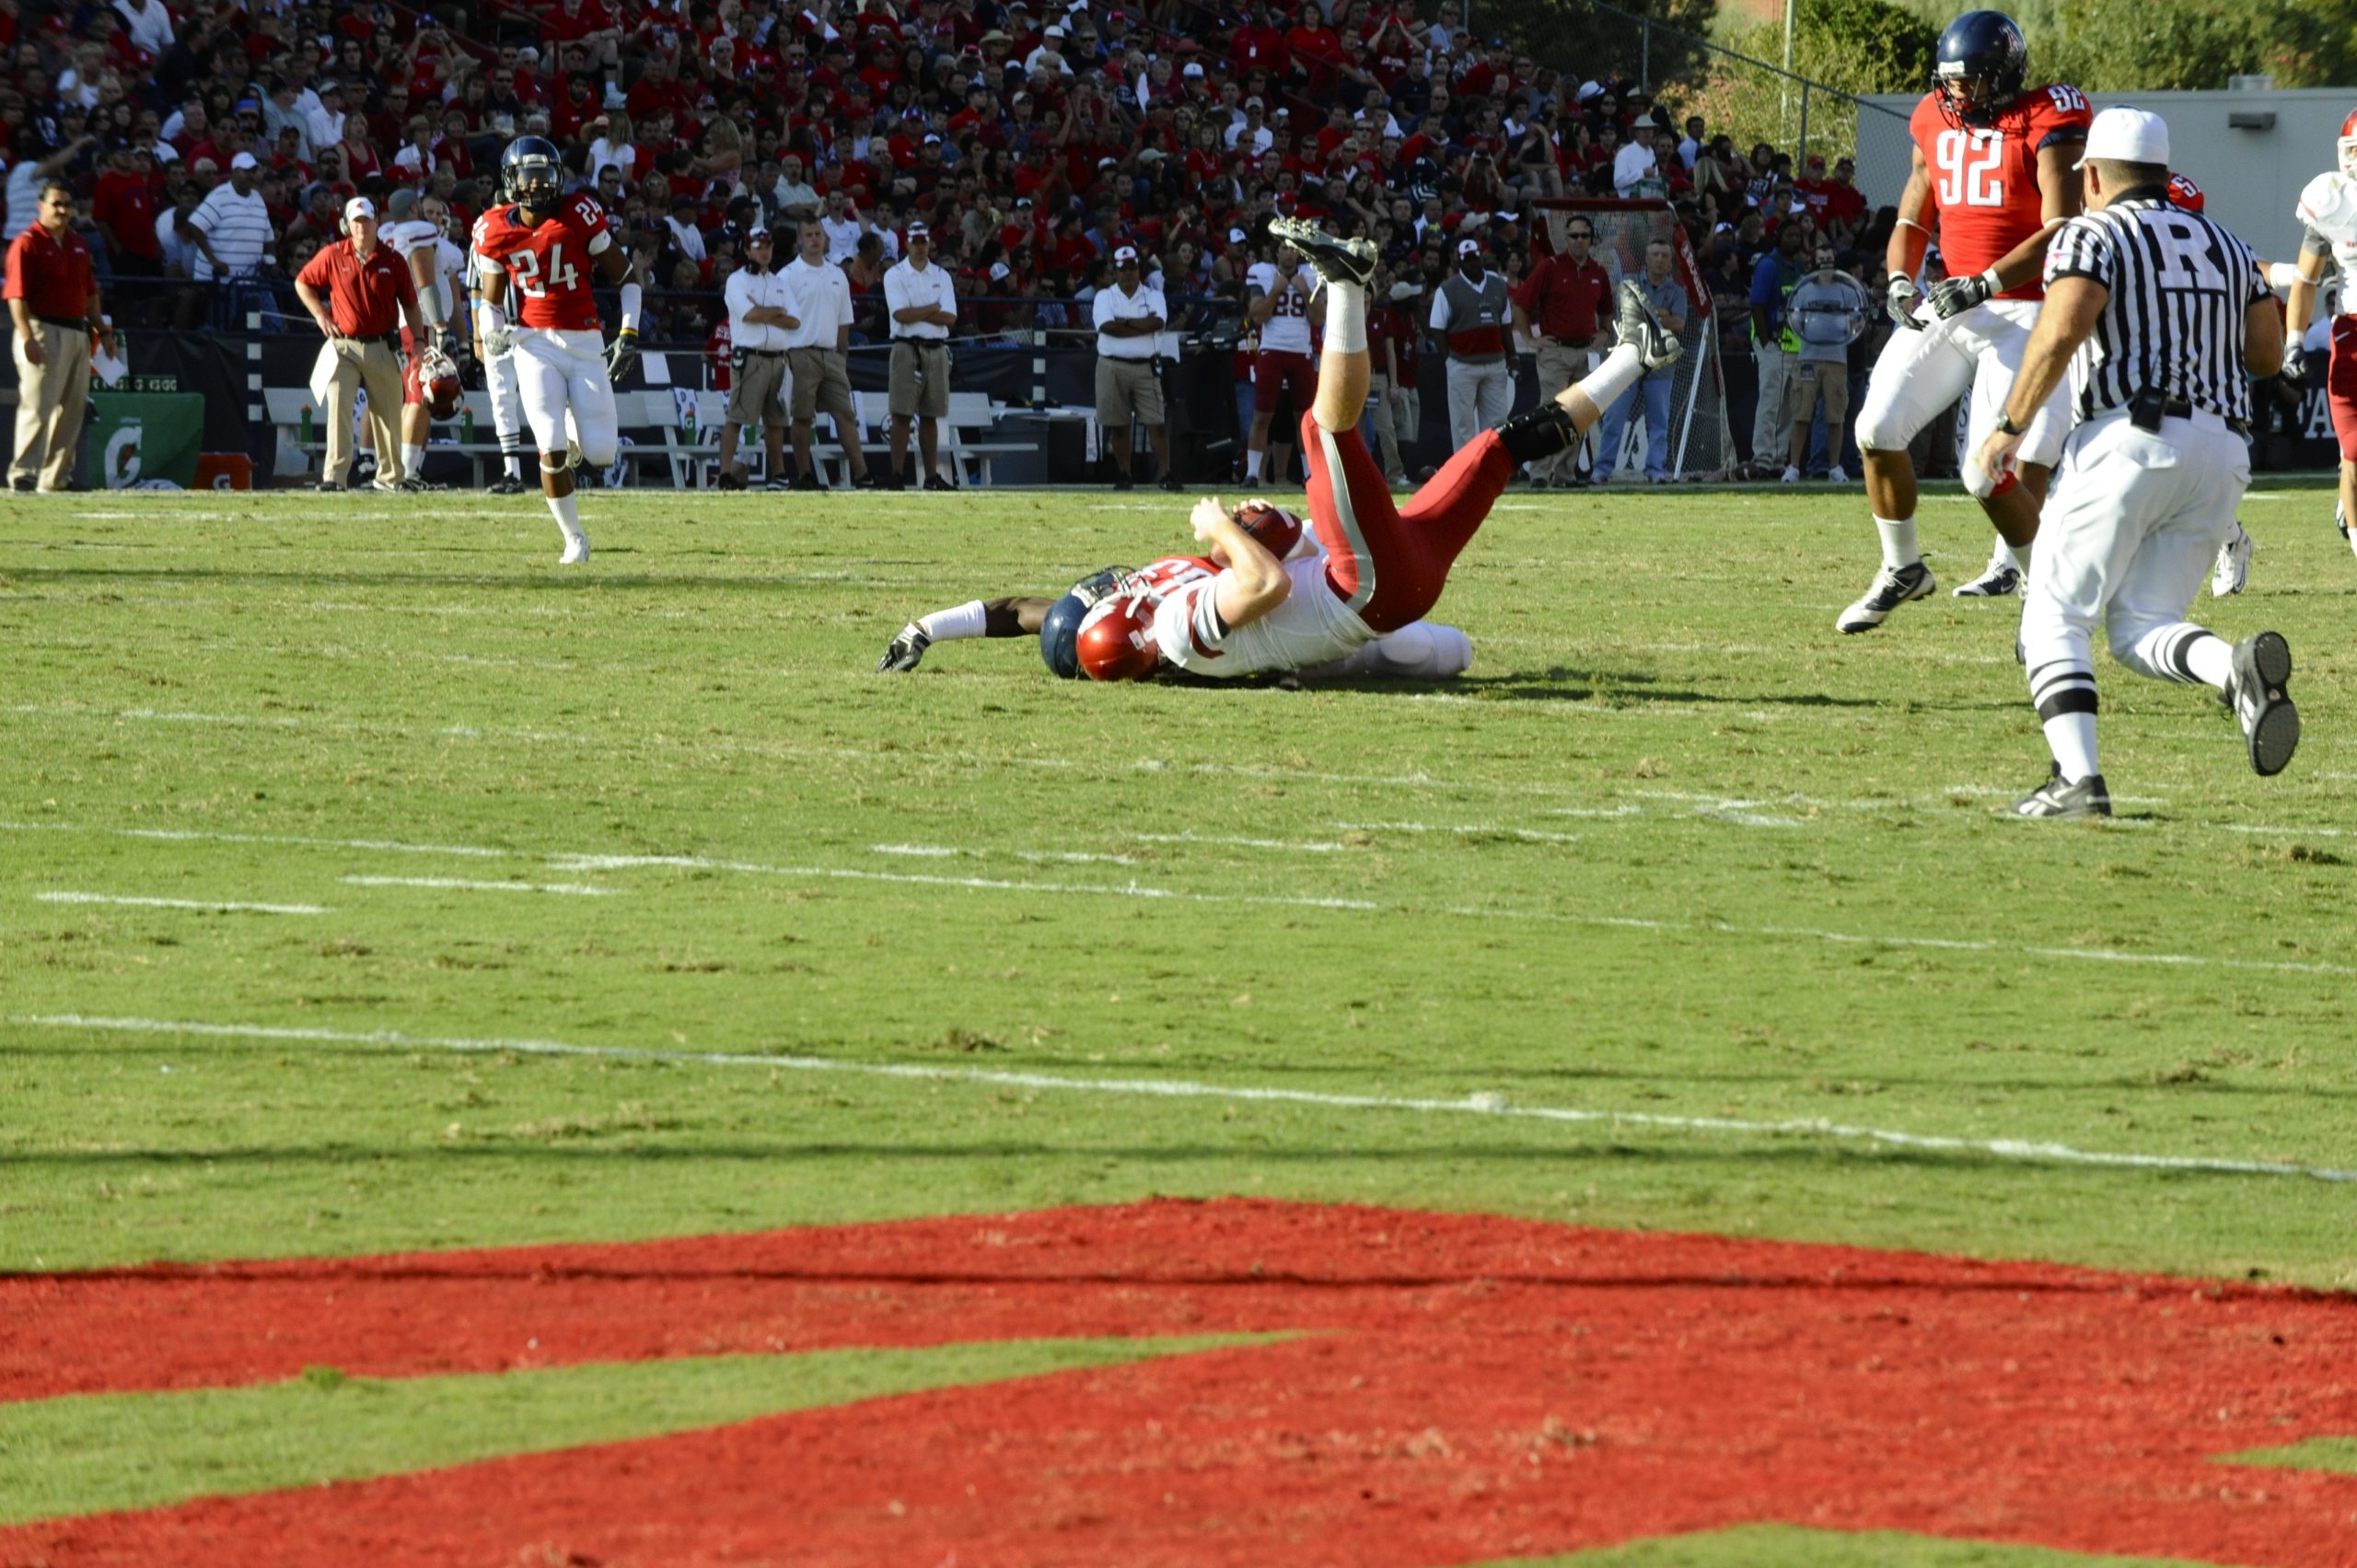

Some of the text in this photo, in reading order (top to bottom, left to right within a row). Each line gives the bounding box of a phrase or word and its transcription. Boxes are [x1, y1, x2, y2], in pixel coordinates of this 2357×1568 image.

[2048, 84, 2084, 112] 92
[1936, 128, 2003, 206] 92
[2170, 174, 2201, 198] 5
[575, 196, 603, 226] 24
[508, 243, 578, 297] 24
[2134, 208, 2226, 290] R
[104, 426, 142, 491] G
